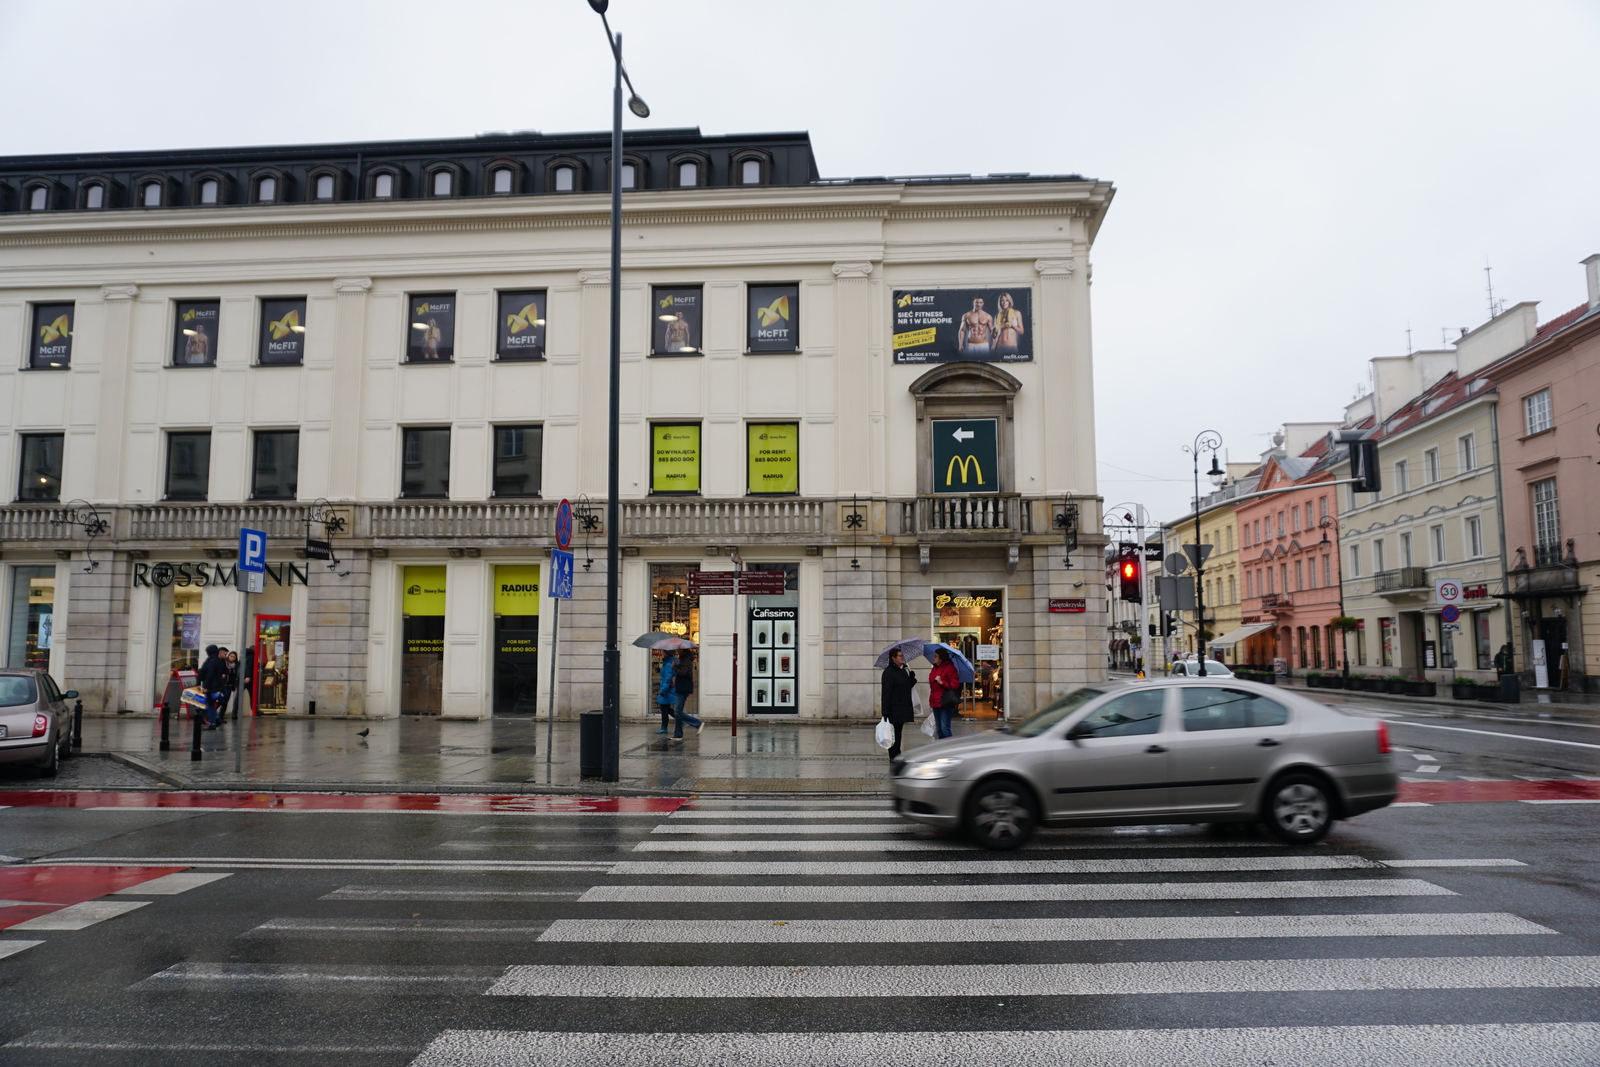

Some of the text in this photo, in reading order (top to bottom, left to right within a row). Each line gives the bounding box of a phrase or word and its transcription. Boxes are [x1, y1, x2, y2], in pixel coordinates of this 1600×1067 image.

[758, 329, 789, 338] McFIT
[507, 335, 537, 344] McFIT
[39, 345, 67, 354] McFIT
[268, 341, 298, 350] McFIT
[245, 533, 261, 566] P
[134, 562, 309, 588] ROSSMNN
[501, 584, 539, 592] RADIUS
[1443, 587, 1456, 596] 30
[953, 596, 998, 608] Tchibo
[1049, 599, 1086, 609] Świętokrzyska
[752, 609, 795, 618] Cafissimo
